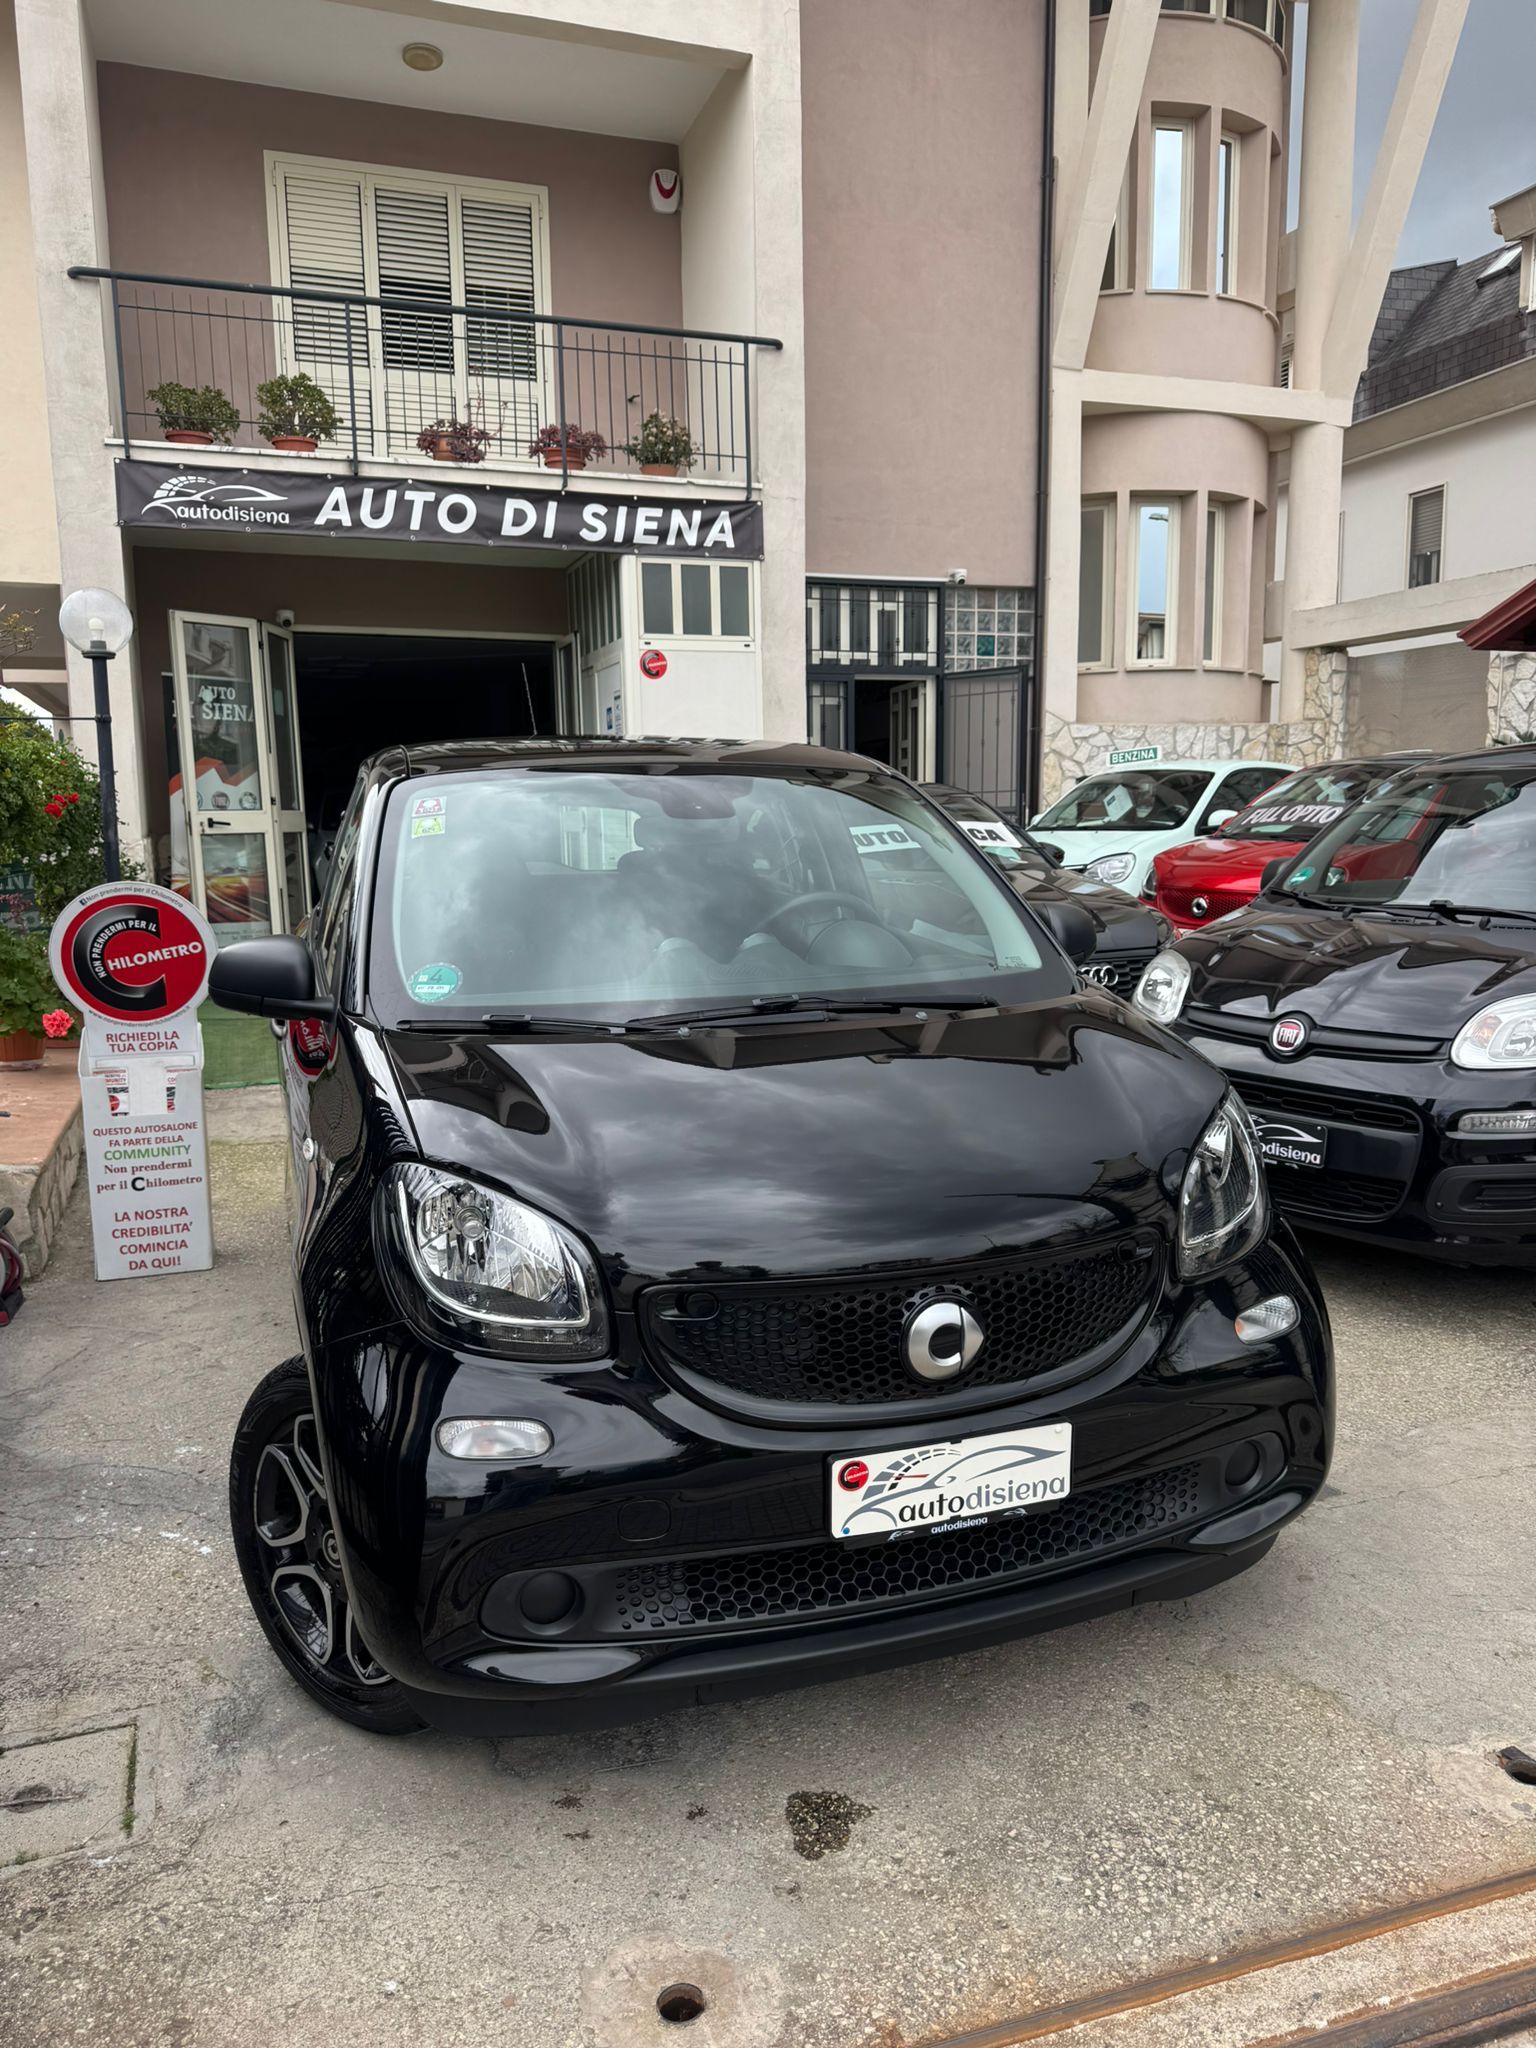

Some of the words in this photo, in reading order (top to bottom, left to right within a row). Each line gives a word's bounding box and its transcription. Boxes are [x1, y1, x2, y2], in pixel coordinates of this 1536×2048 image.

[176, 503, 290, 525] autodisiena
[314, 486, 478, 534] AUTO
[500, 498, 558, 539] DI
[579, 503, 735, 549] SIENA
[1111, 748, 1155, 763] BENZINA
[1241, 805, 1287, 825] FULL
[128, 919, 147, 929] PER
[147, 922, 157, 932] IL
[91, 923, 127, 959] PRENDERMI
[94, 961, 107, 979] NON
[106, 1032, 161, 1043] RICHIEDI
[164, 1030, 180, 1040] LA
[1279, 1027, 1299, 1045] FIAT
[109, 1042, 136, 1053] TUA
[138, 1041, 179, 1052] COPIA
[92, 1126, 132, 1137] QUESTO
[134, 1121, 199, 1134] AUTOSALONE
[109, 1139, 121, 1147] FA
[123, 1136, 152, 1147] PARTE
[154, 1135, 184, 1145] DELLA
[104, 1144, 192, 1161] COMMUNITY
[104, 1165, 128, 1175] Non
[131, 1158, 193, 1175] prendermi
[96, 1183, 117, 1194] per
[119, 1180, 128, 1190] il
[131, 1176, 203, 1192] Chilometro
[114, 1211, 131, 1223] LA
[134, 1206, 189, 1221] NOSTRA
[119, 1239, 189, 1255] COMINCIA
[129, 1259, 148, 1271] DA
[151, 1255, 182, 1269] QUI!
[898, 1475, 1066, 1523] autodisiena
[930, 1516, 988, 1535] autodisiena
